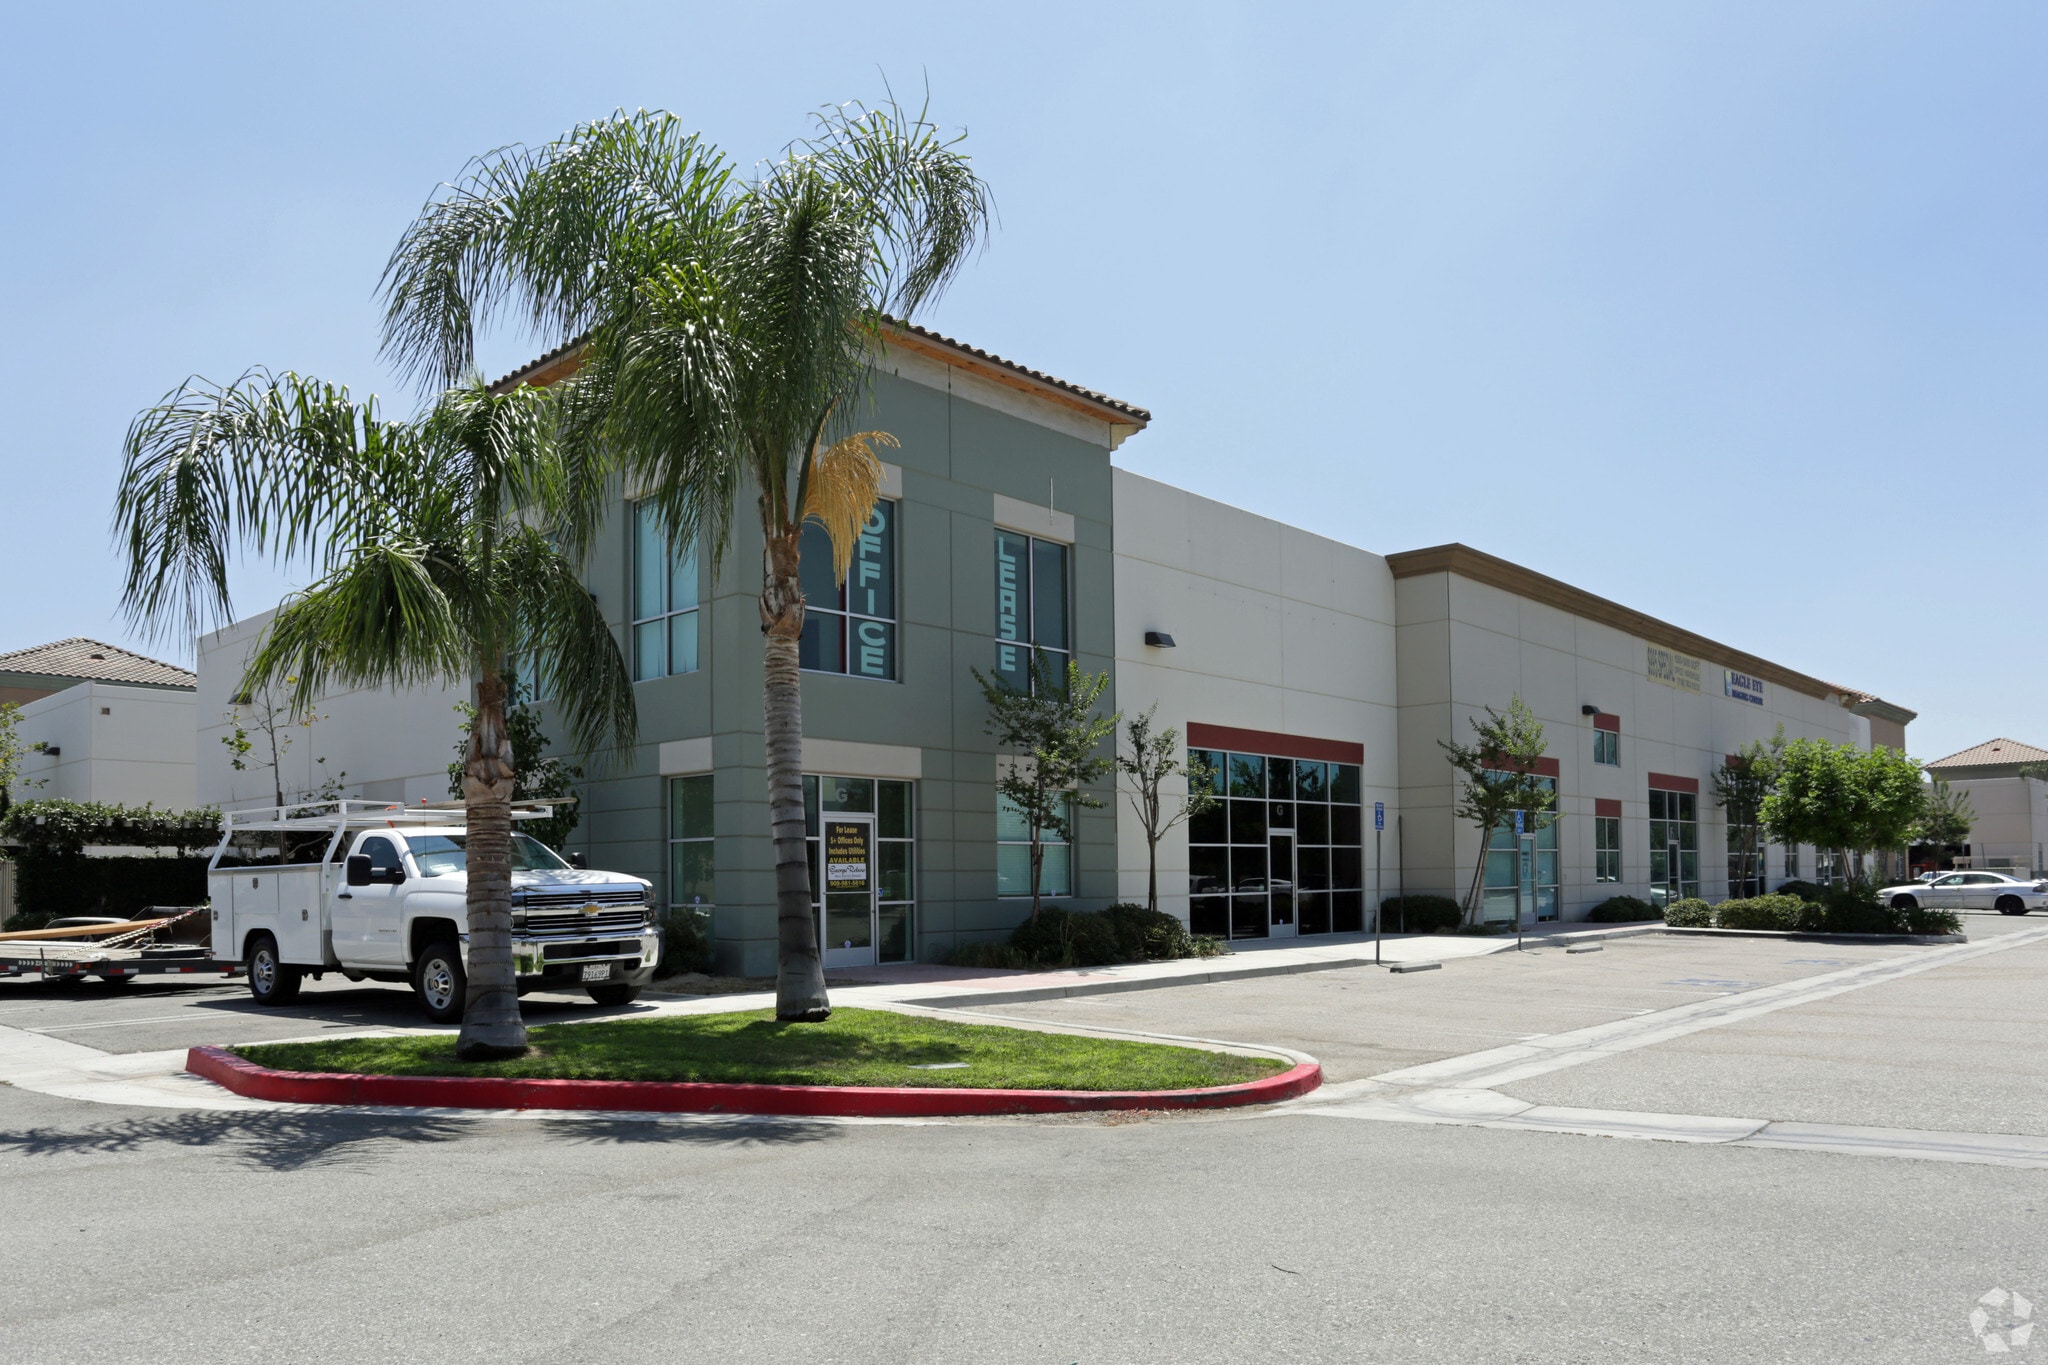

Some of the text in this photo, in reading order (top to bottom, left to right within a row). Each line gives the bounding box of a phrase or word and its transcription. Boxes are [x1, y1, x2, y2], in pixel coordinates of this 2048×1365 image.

[858, 508, 886, 676] OFFICE
[999, 536, 1016, 672] LEASE
[1731, 672, 1763, 693] EAGLE EYE
[836, 787, 848, 803] G
[1276, 804, 1284, 816] G
[844, 826, 857, 834] Lease
[837, 836, 853, 844] Offices
[853, 836, 864, 846] Only
[828, 847, 865, 855] Includes Utilities
